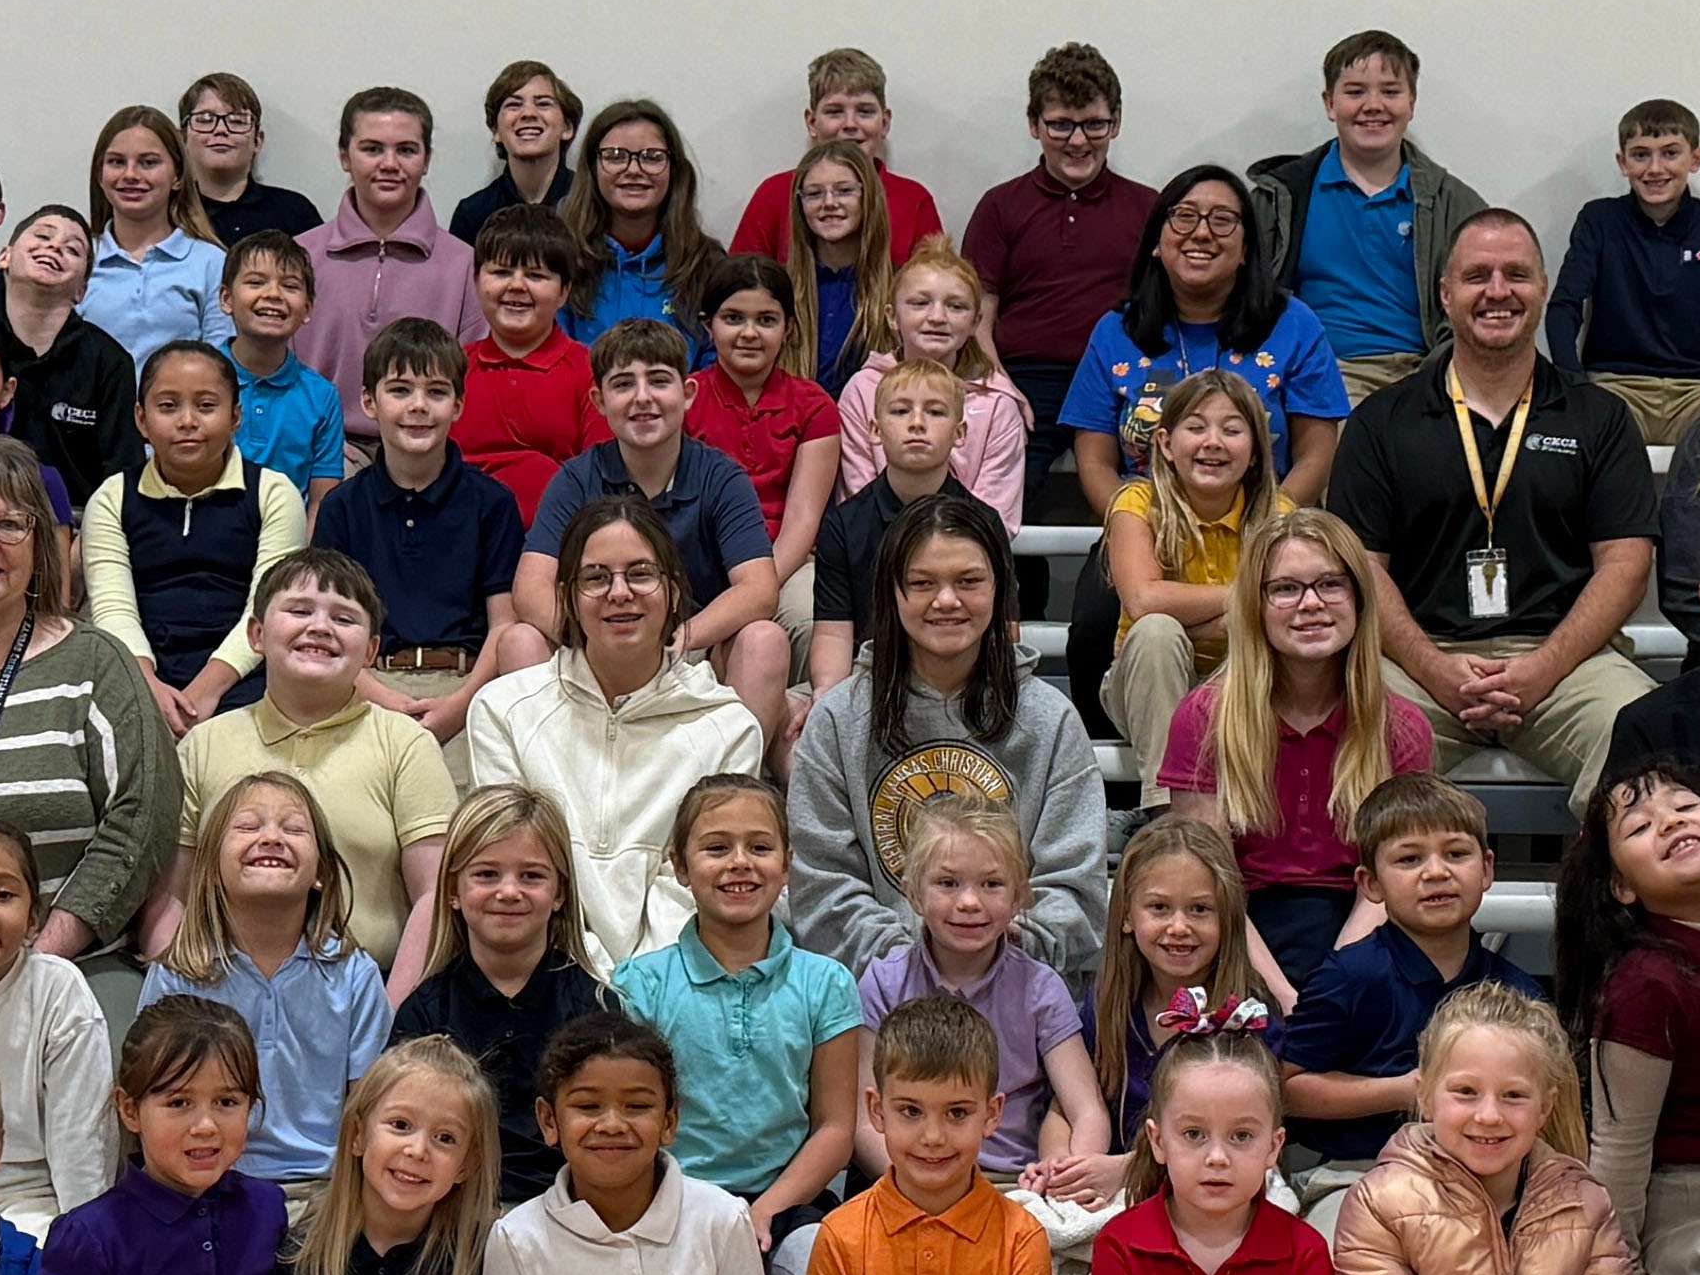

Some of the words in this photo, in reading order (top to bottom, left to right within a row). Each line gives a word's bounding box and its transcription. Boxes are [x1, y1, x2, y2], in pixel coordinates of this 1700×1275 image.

[881, 754, 930, 803] KANSAS
[933, 750, 1004, 798] CHRISTIAN
[875, 805, 906, 869] CENTRAL
